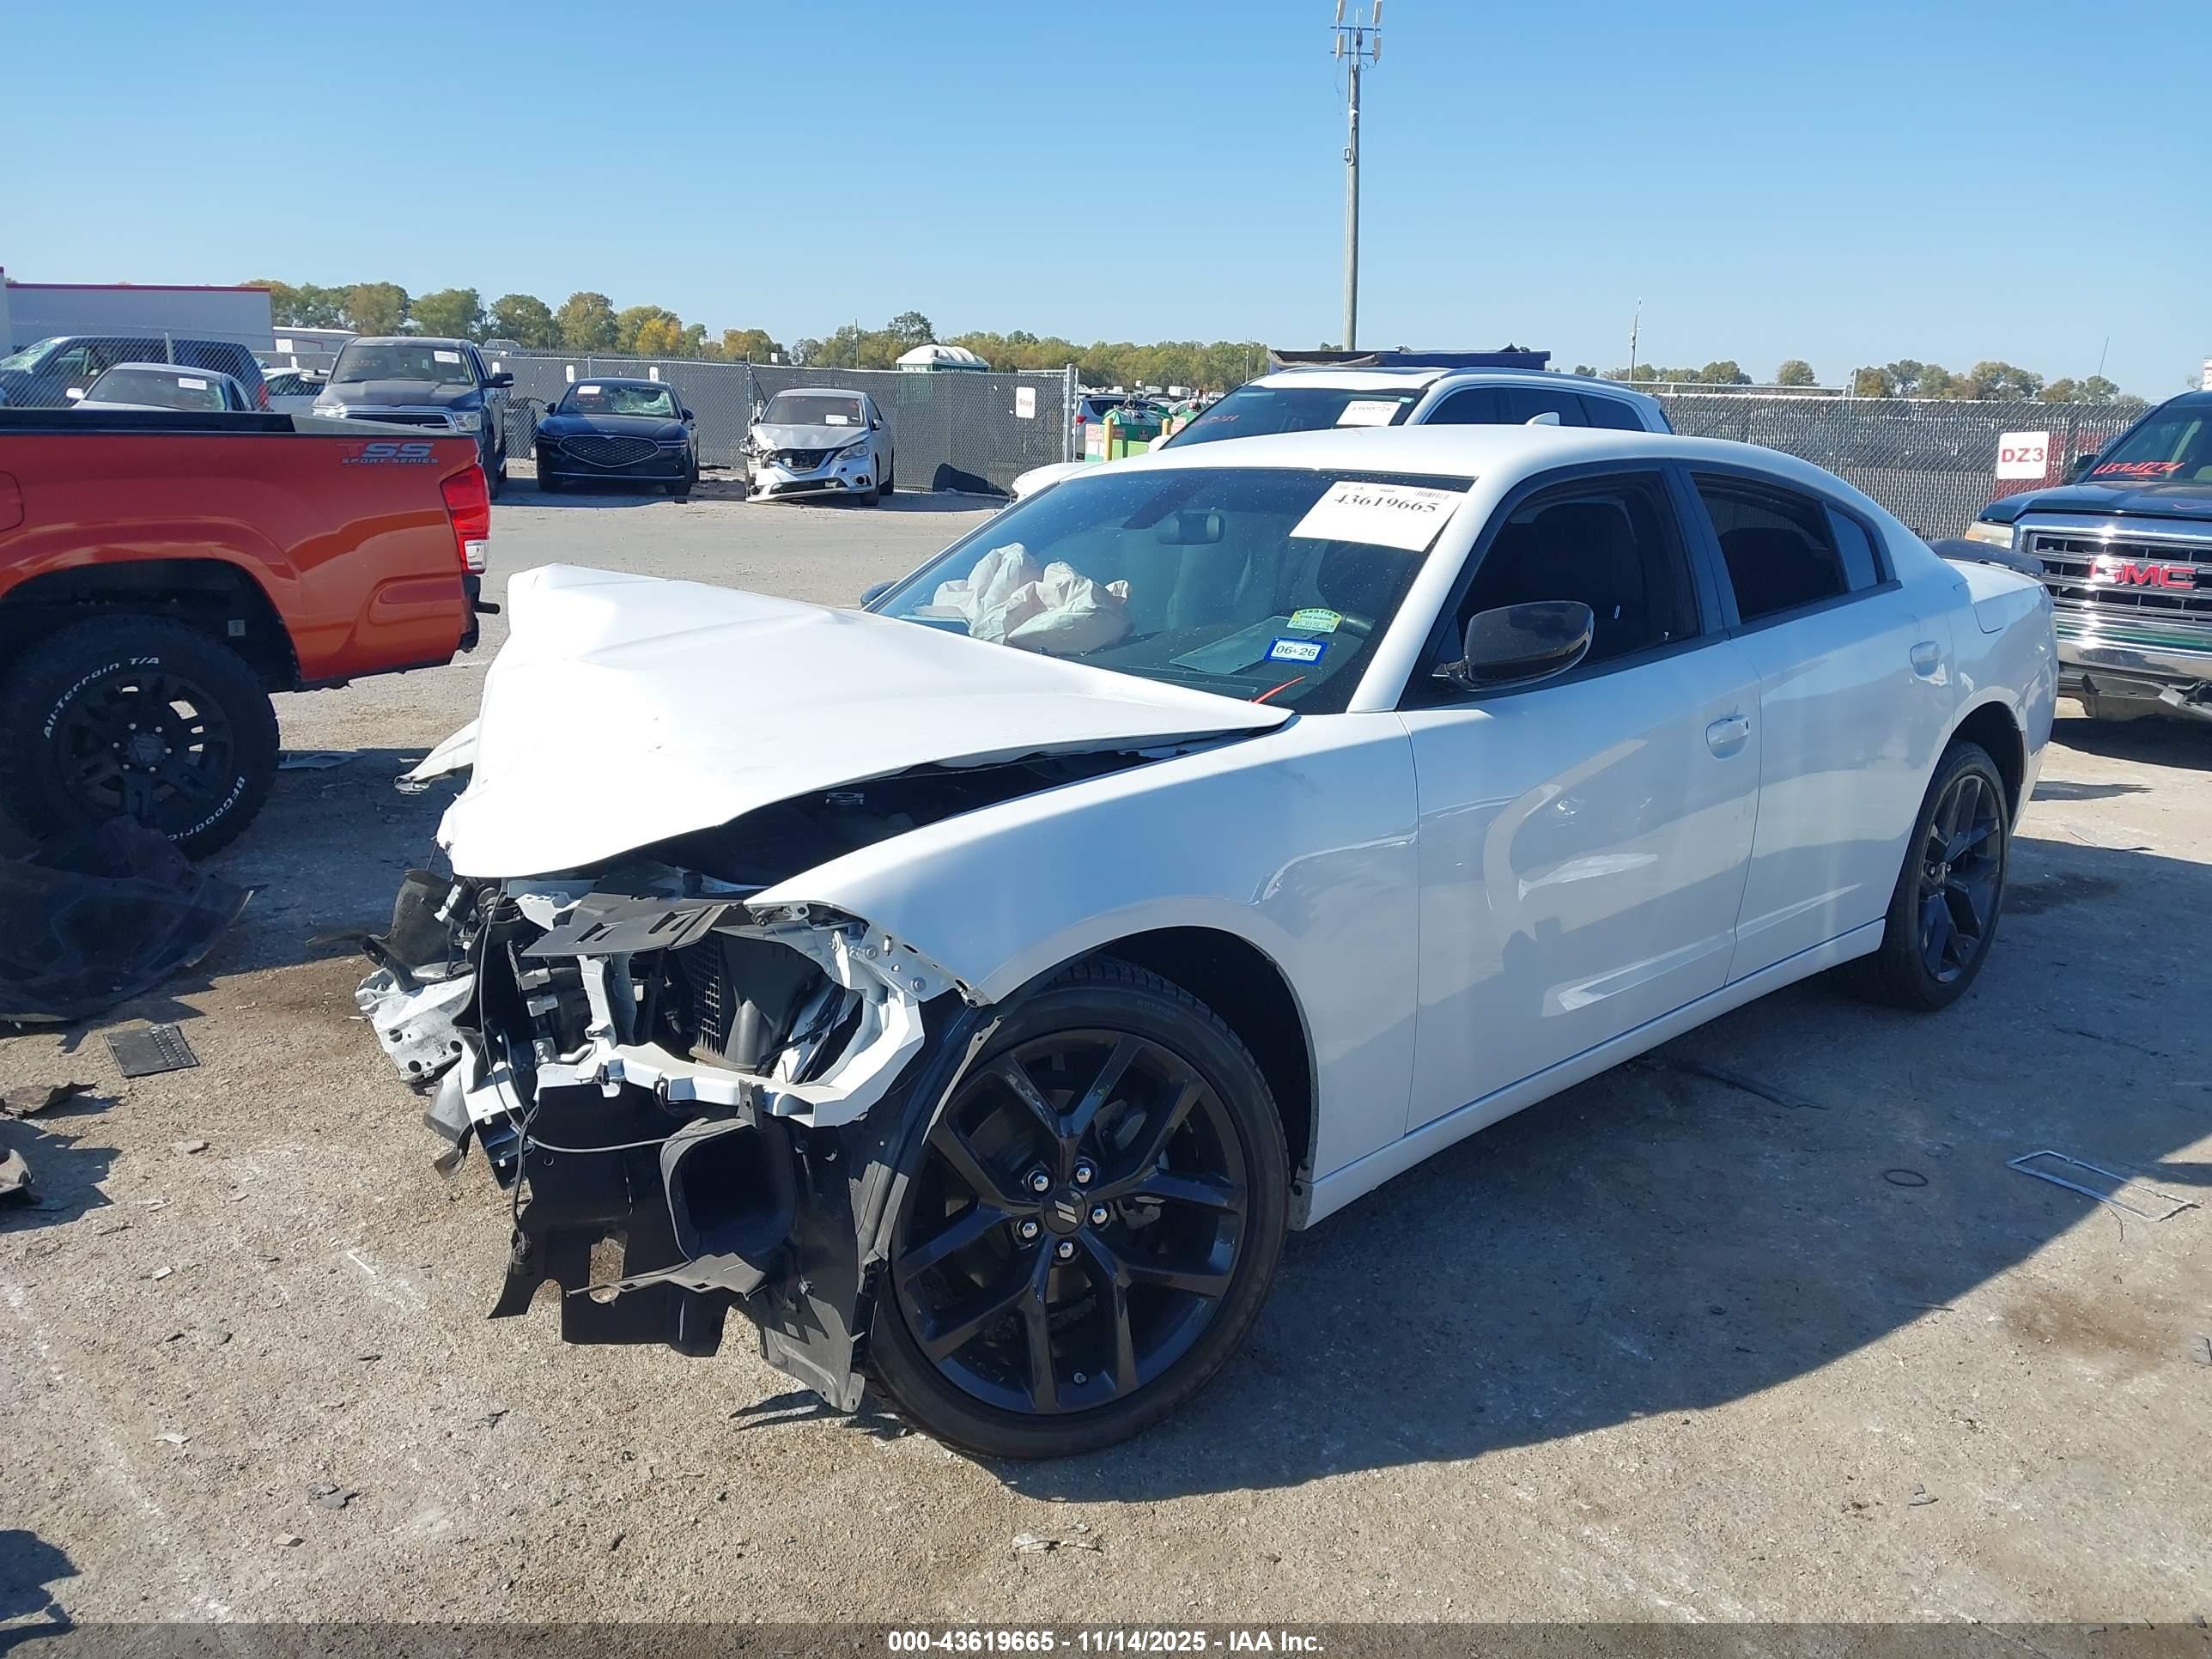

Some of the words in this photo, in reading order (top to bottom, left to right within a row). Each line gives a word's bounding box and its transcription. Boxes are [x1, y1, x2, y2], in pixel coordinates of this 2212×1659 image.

[1018, 398, 1033, 407] Stop
[2002, 447, 2045, 463] DZ3
[1334, 493, 1441, 514] 43619665
[2089, 559, 2198, 590] GMC
[1276, 645, 1294, 654] 06
[1298, 647, 1317, 657] 26
[43, 662, 120, 738] All-Terrain
[129, 657, 161, 665] T/A
[167, 775, 246, 842] BFGoodric
